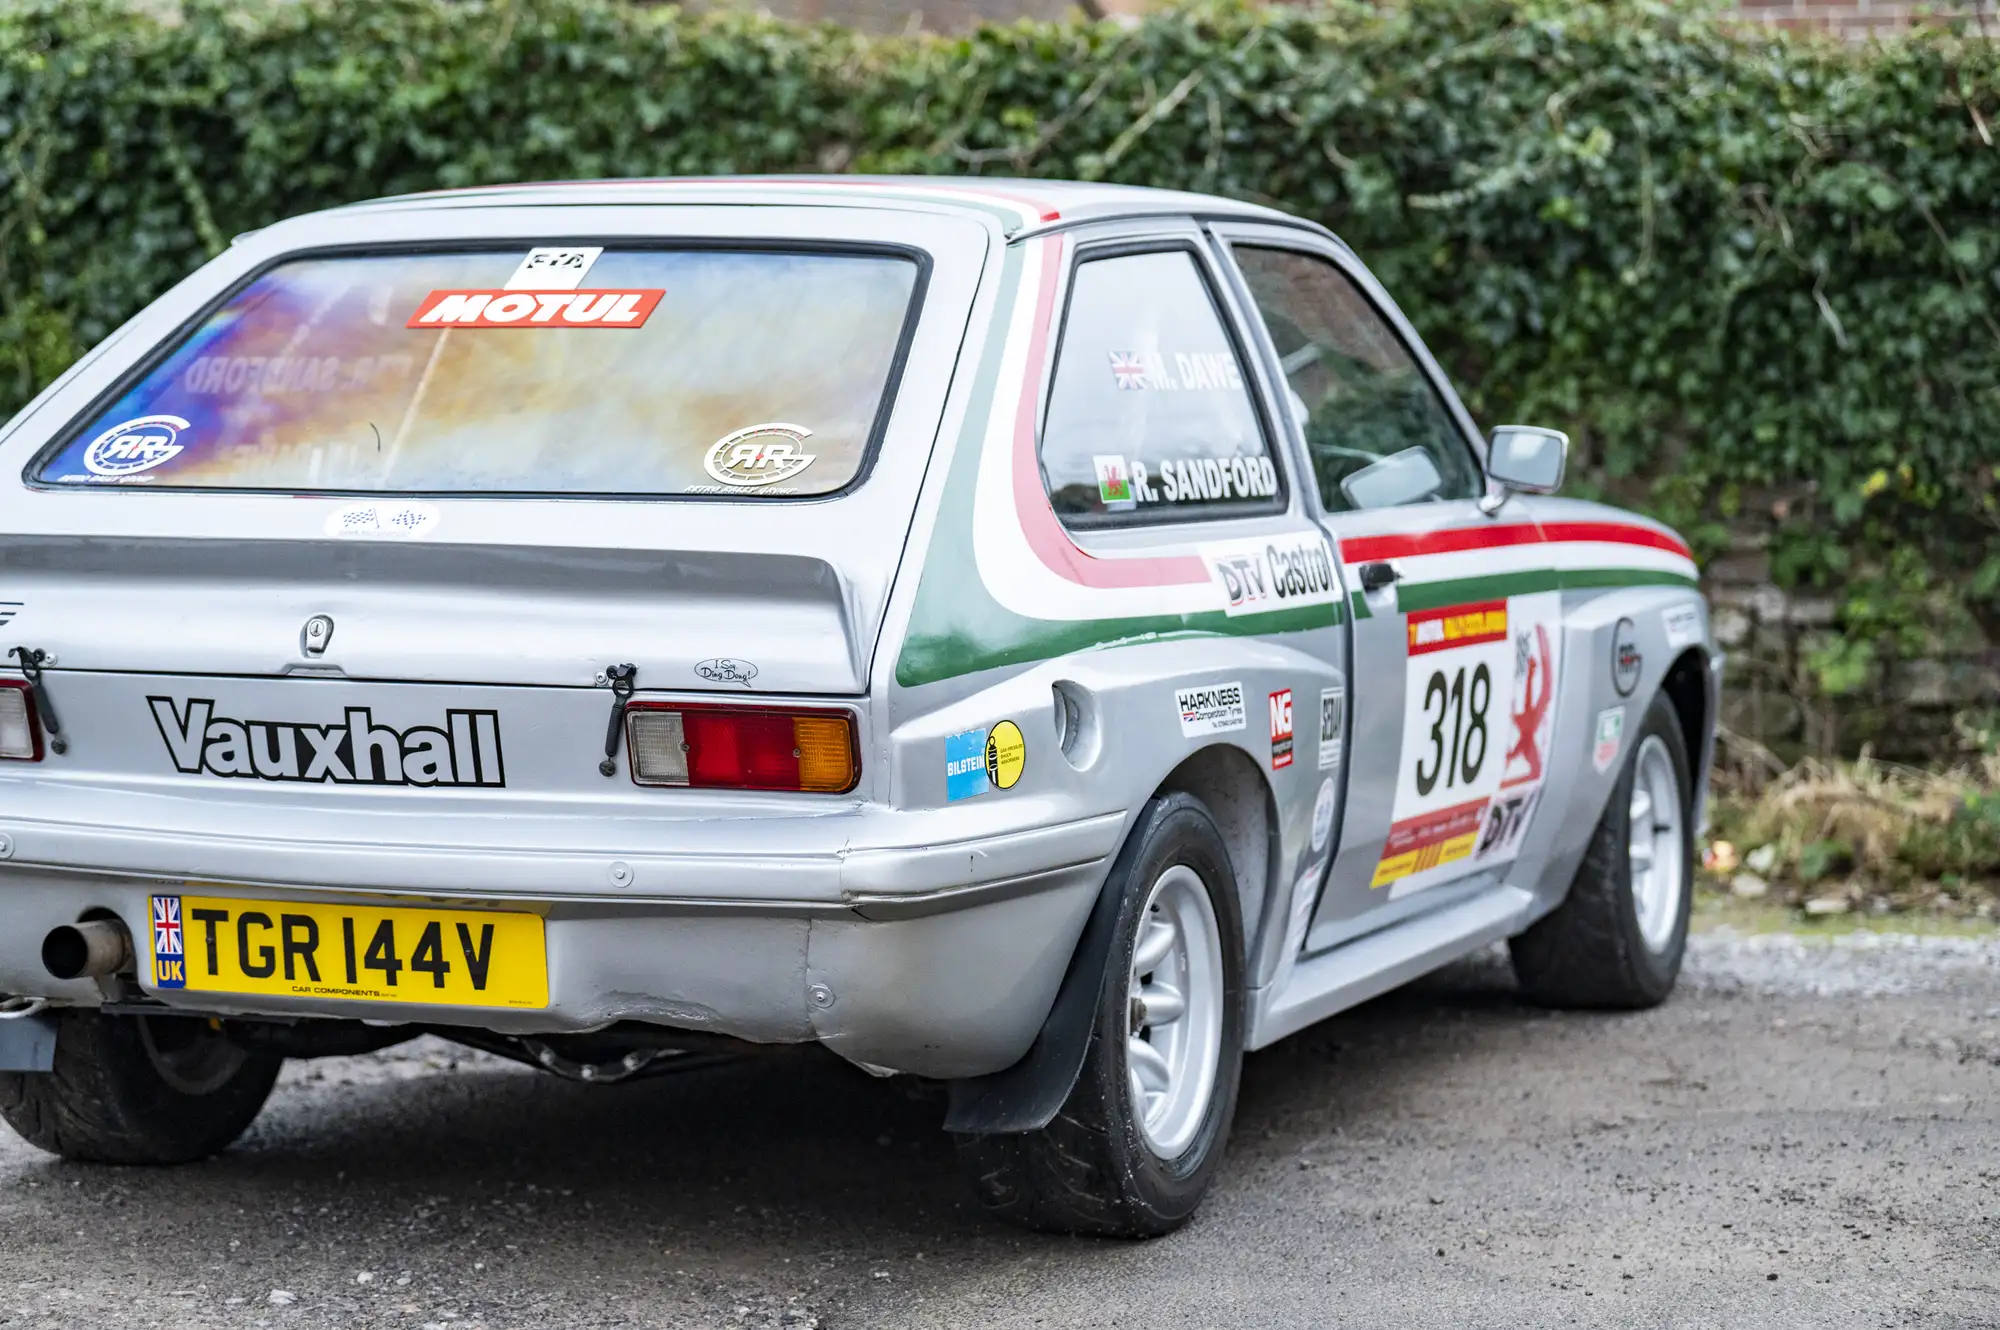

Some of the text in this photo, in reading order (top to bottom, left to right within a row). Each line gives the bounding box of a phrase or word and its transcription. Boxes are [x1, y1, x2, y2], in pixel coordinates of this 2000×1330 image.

[418, 293, 643, 323] MOTUL
[1131, 456, 1278, 502] R. SANDFORD
[1266, 541, 1334, 598] Castrol
[700, 667, 751, 682] Ding Dong!
[714, 659, 720, 669] I
[1178, 687, 1241, 711] HARKNESS
[1270, 691, 1292, 738] NG
[1416, 662, 1491, 797] 318
[146, 695, 506, 788] Vauxhall
[947, 754, 985, 777] BILSTEIN
[191, 908, 495, 991] TGR 144V
[157, 960, 184, 982] UK
[292, 985, 311, 993] CAR
[314, 987, 380, 997] COMPONENTS
